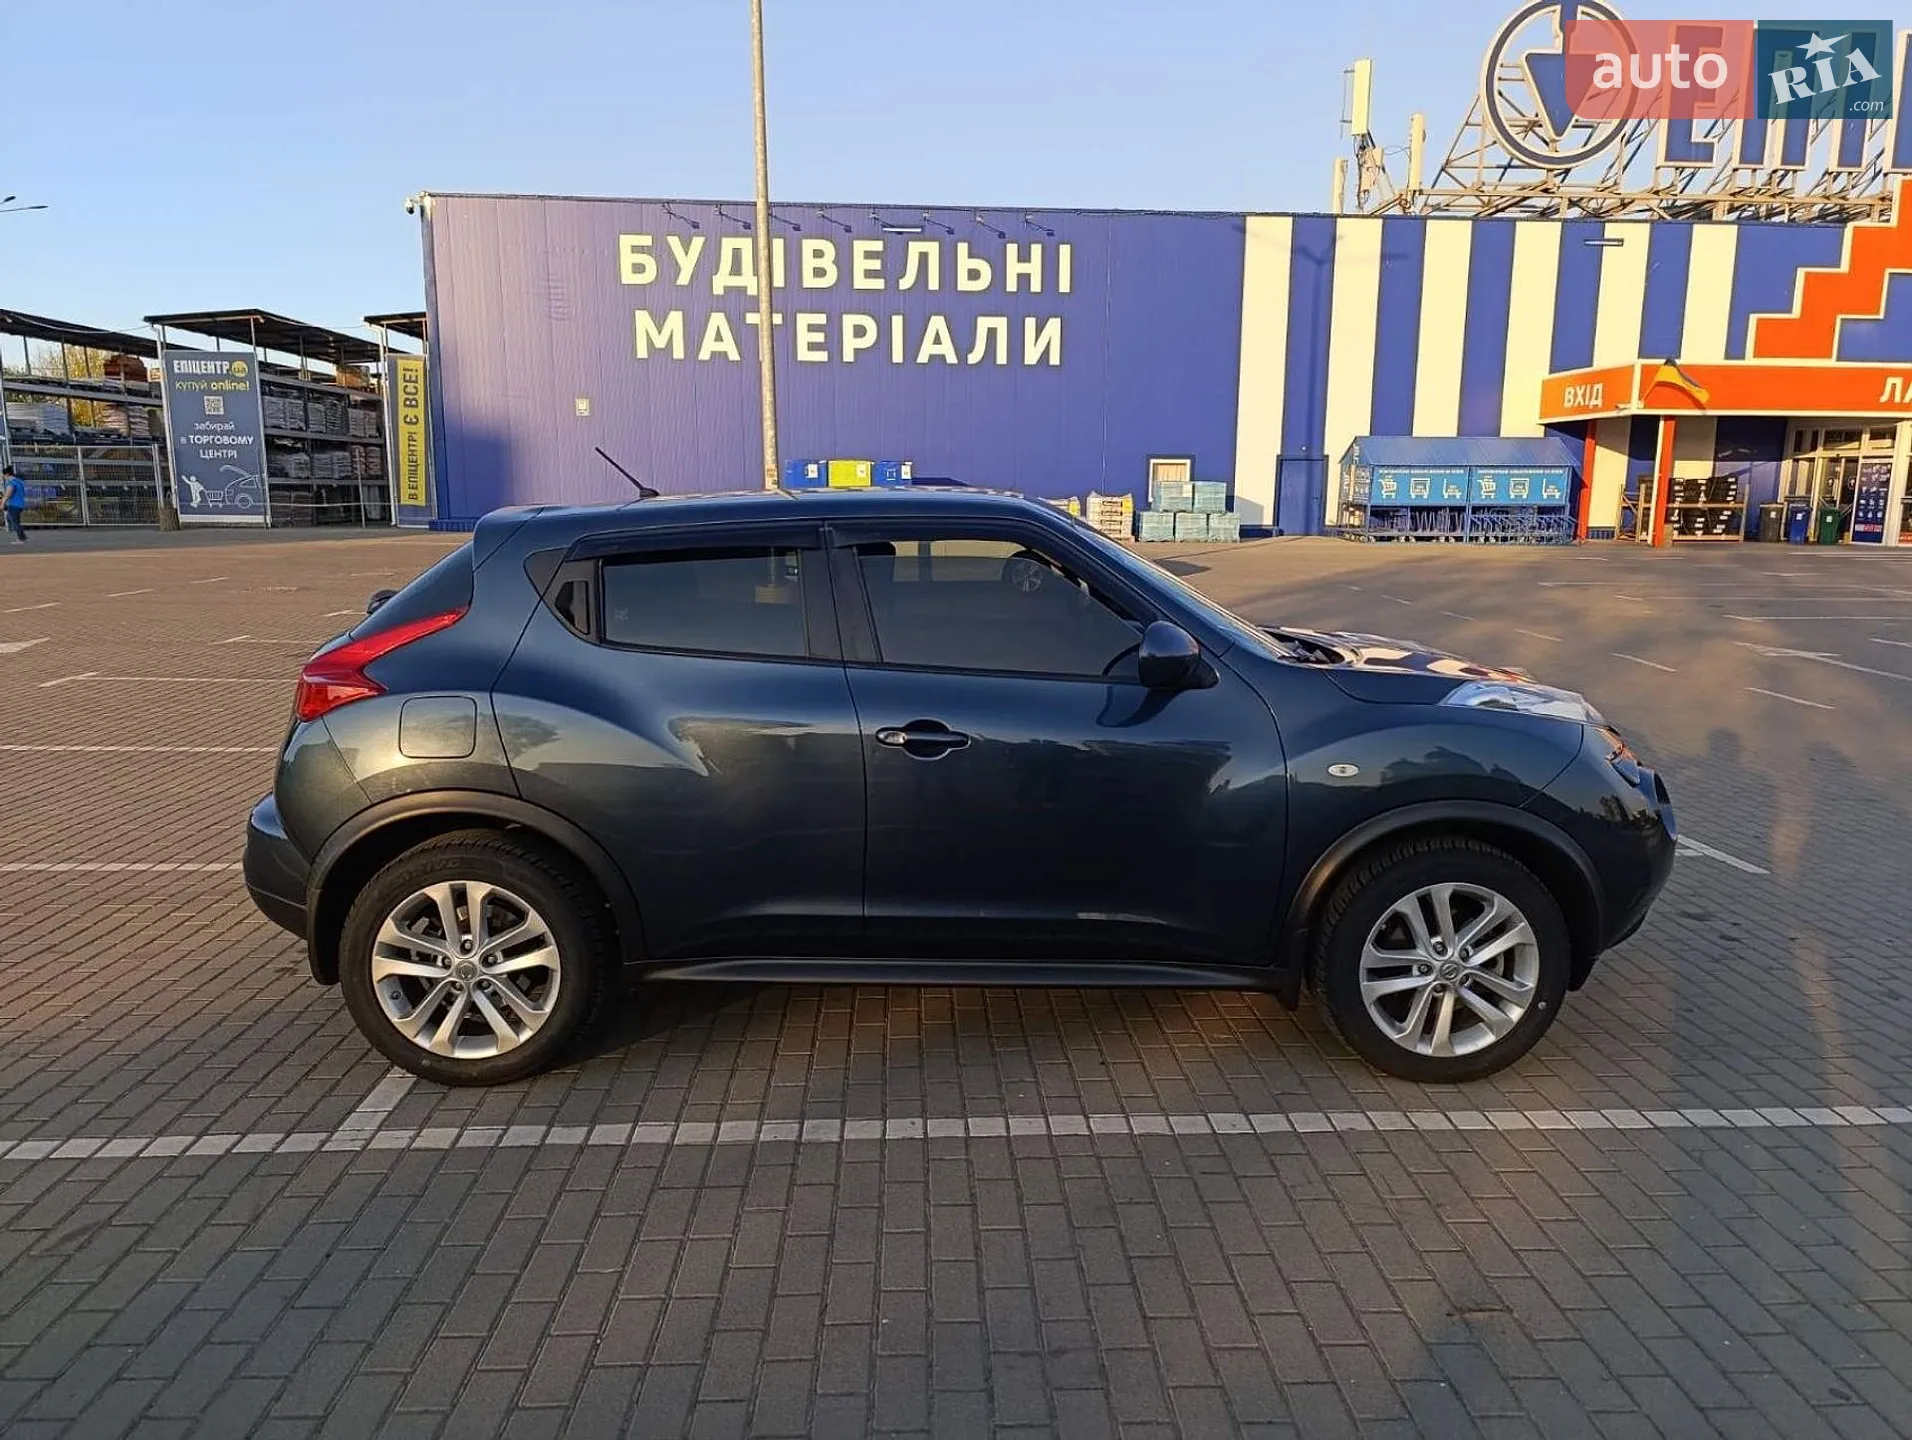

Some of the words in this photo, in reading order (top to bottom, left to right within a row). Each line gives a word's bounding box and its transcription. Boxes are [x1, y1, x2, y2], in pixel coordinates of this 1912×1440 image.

[618, 234, 1072, 296] БУДІВЕЛЬНІ
[175, 381, 207, 392] купуй
[211, 380, 250, 391] online!
[403, 368, 419, 408] ВСЕ!
[1563, 383, 1603, 408] ВХІД
[194, 421, 235, 432] забирай
[188, 435, 254, 445] ТОРГОВОМУ
[200, 449, 237, 460] ЦЕНТРІ
